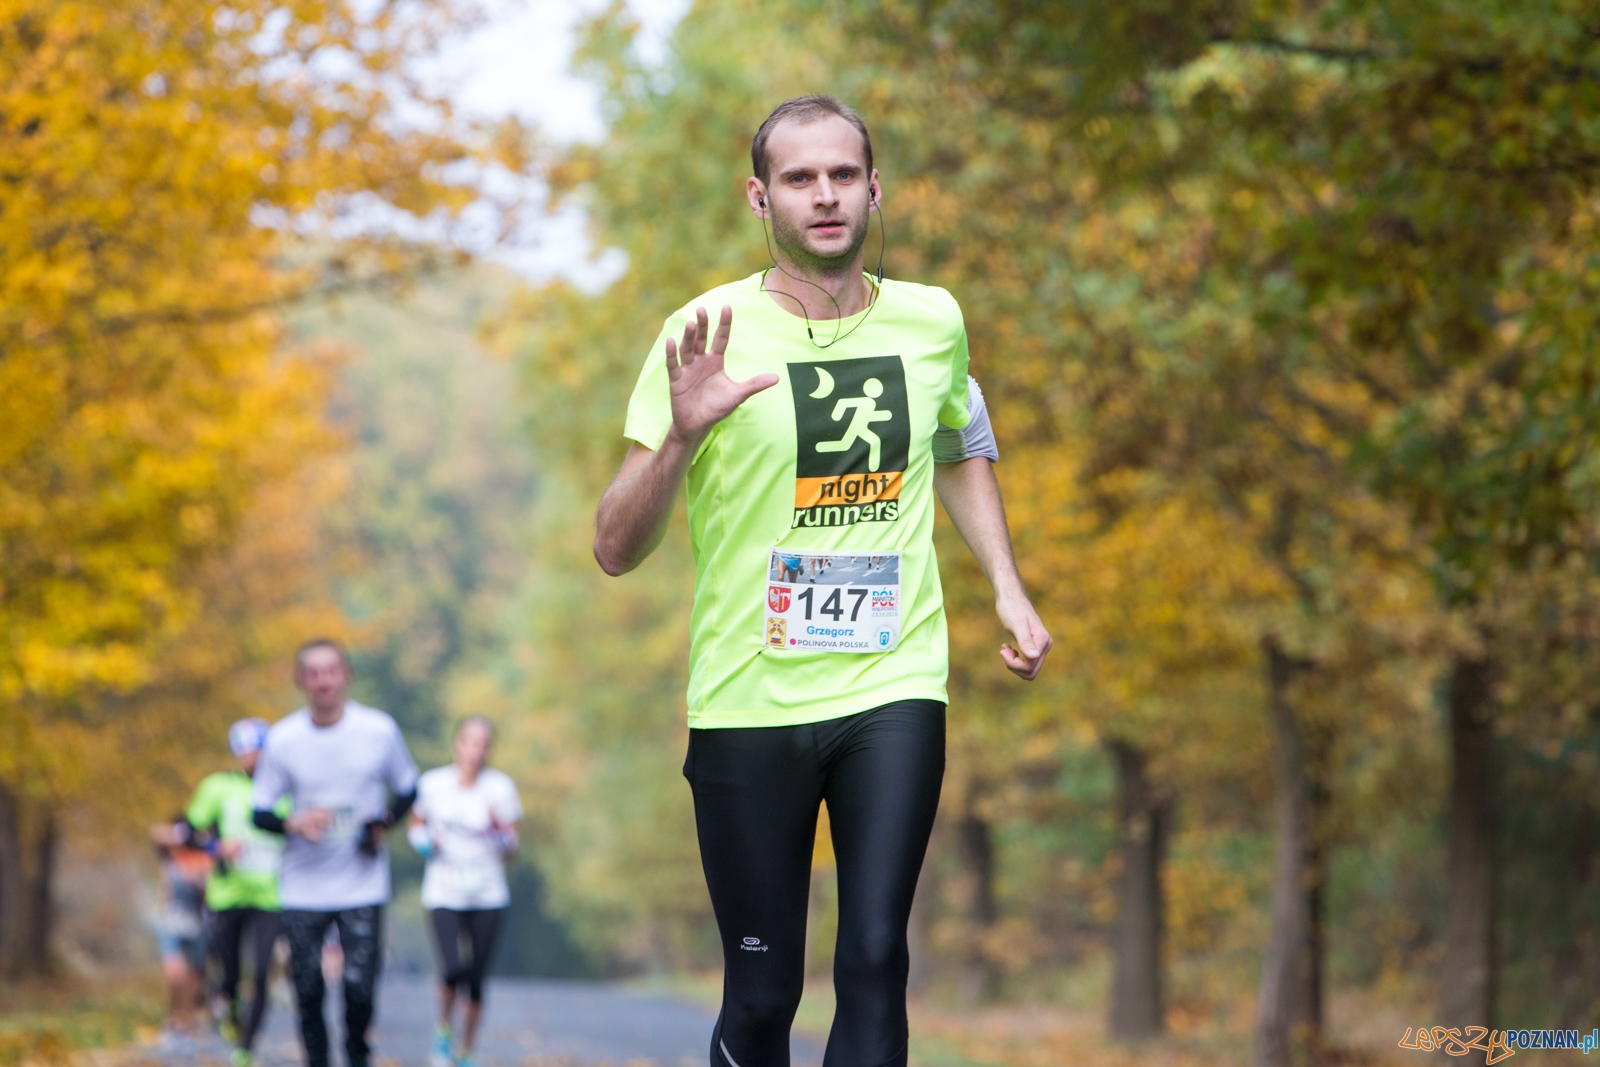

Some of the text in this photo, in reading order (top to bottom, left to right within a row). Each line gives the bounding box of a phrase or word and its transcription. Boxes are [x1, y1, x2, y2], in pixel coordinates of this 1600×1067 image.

[821, 474, 889, 503] night
[792, 501, 899, 528] runners
[797, 587, 868, 622] 147
[797, 639, 837, 648] POLINOVA
[806, 625, 854, 638] Grzegorz
